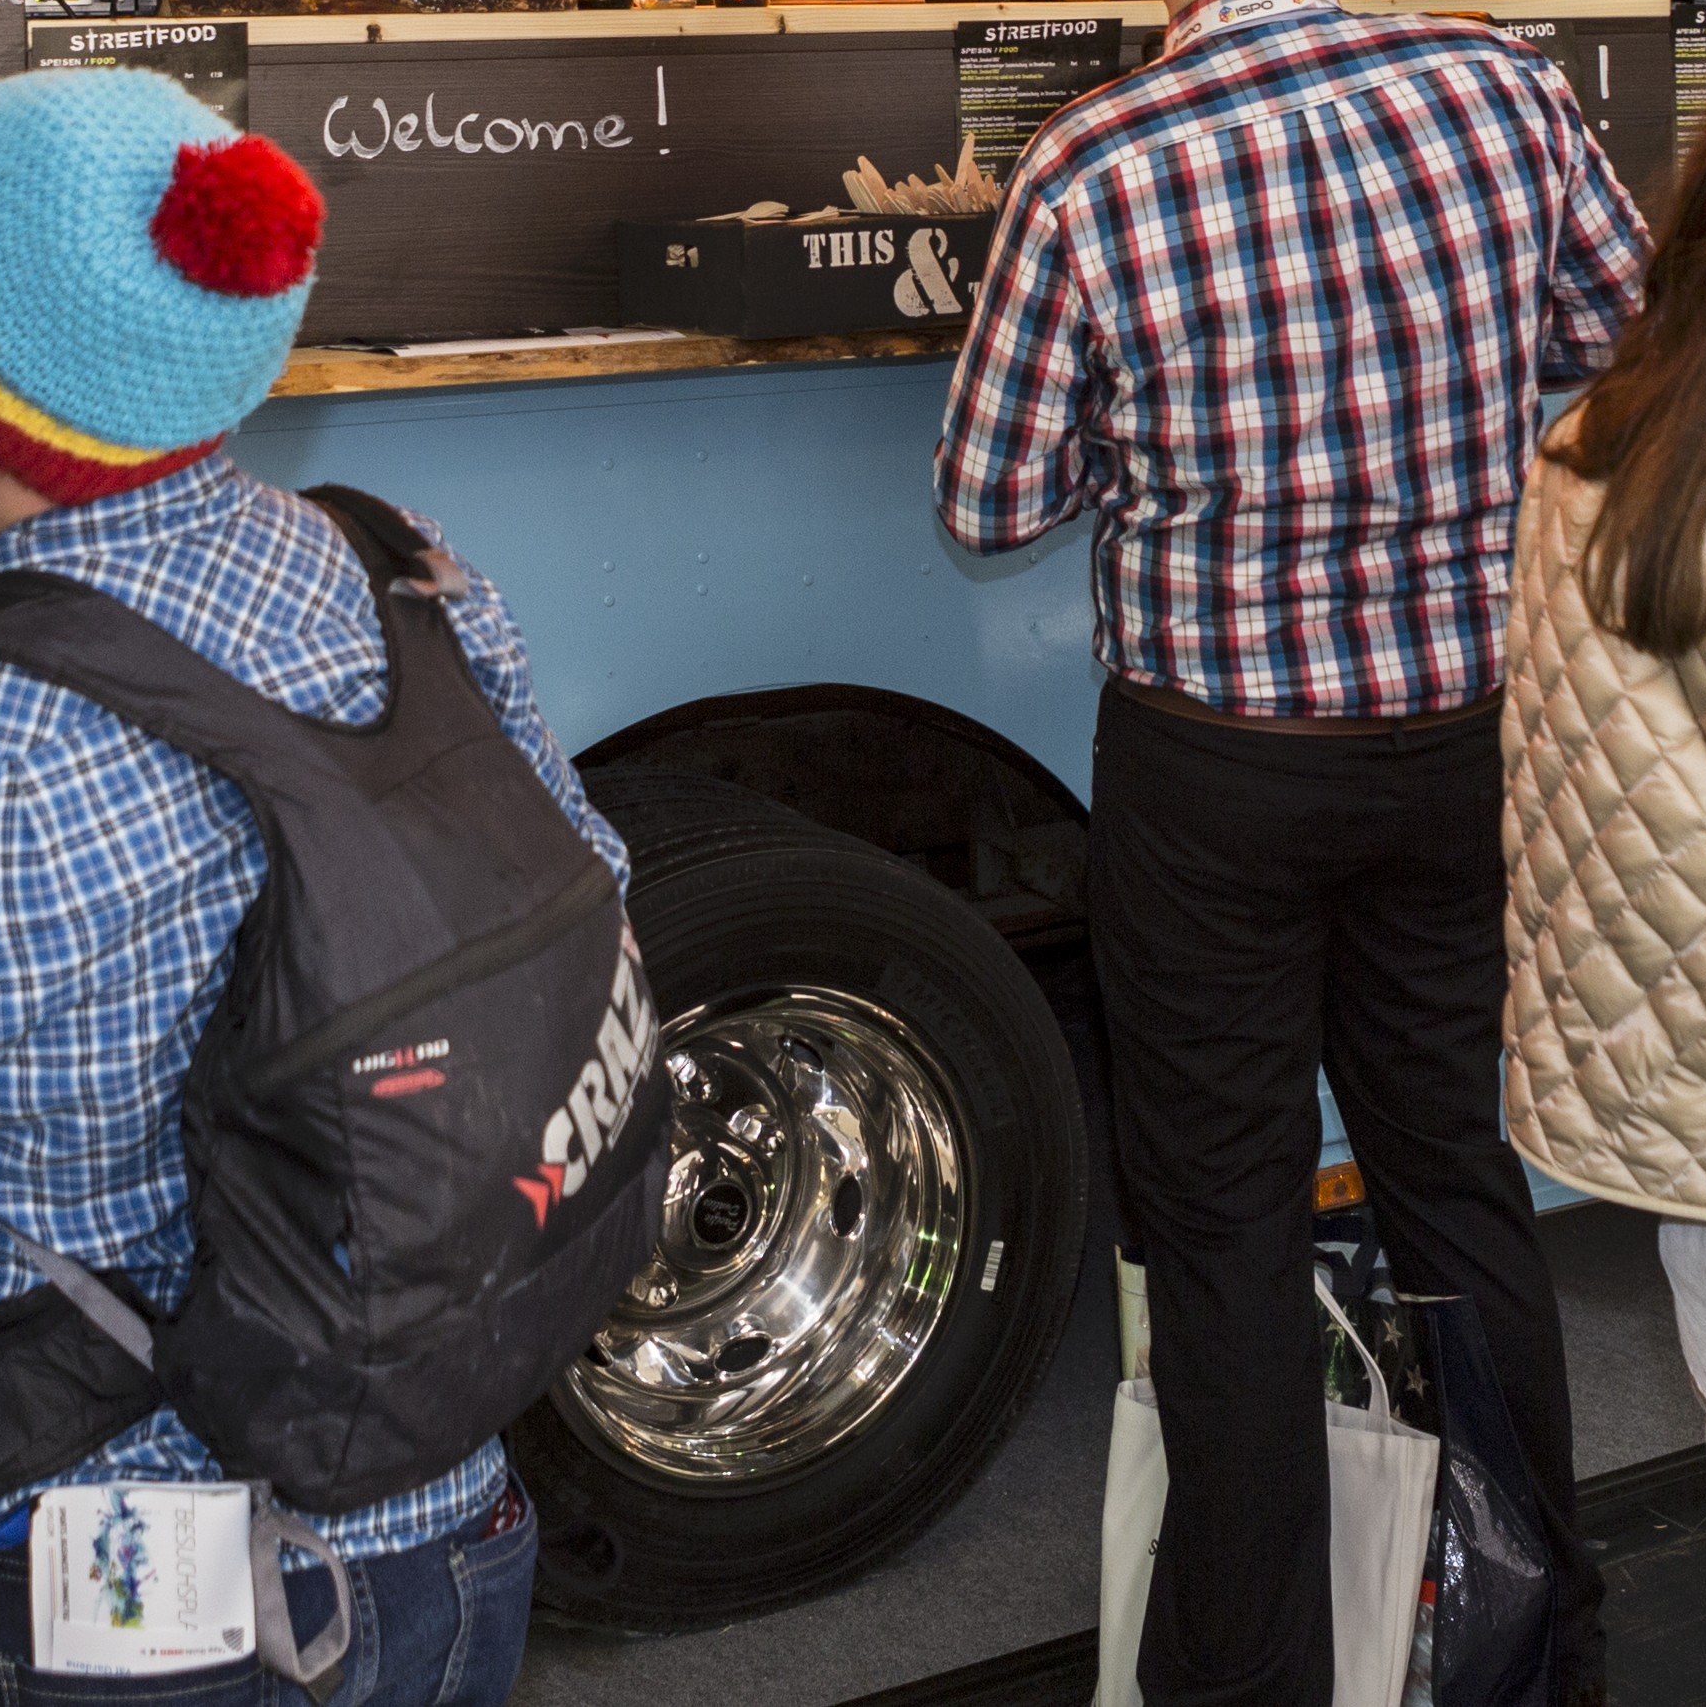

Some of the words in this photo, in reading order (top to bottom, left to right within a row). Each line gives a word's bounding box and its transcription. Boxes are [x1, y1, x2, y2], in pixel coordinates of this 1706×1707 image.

[1235, 0, 1274, 17] ISPO
[69, 23, 218, 54] STREETFOOD
[984, 19, 1099, 43] STREETFOOD
[40, 57, 82, 67] SPEISEN
[90, 56, 116, 66] FOOD
[803, 229, 895, 269] THIS
